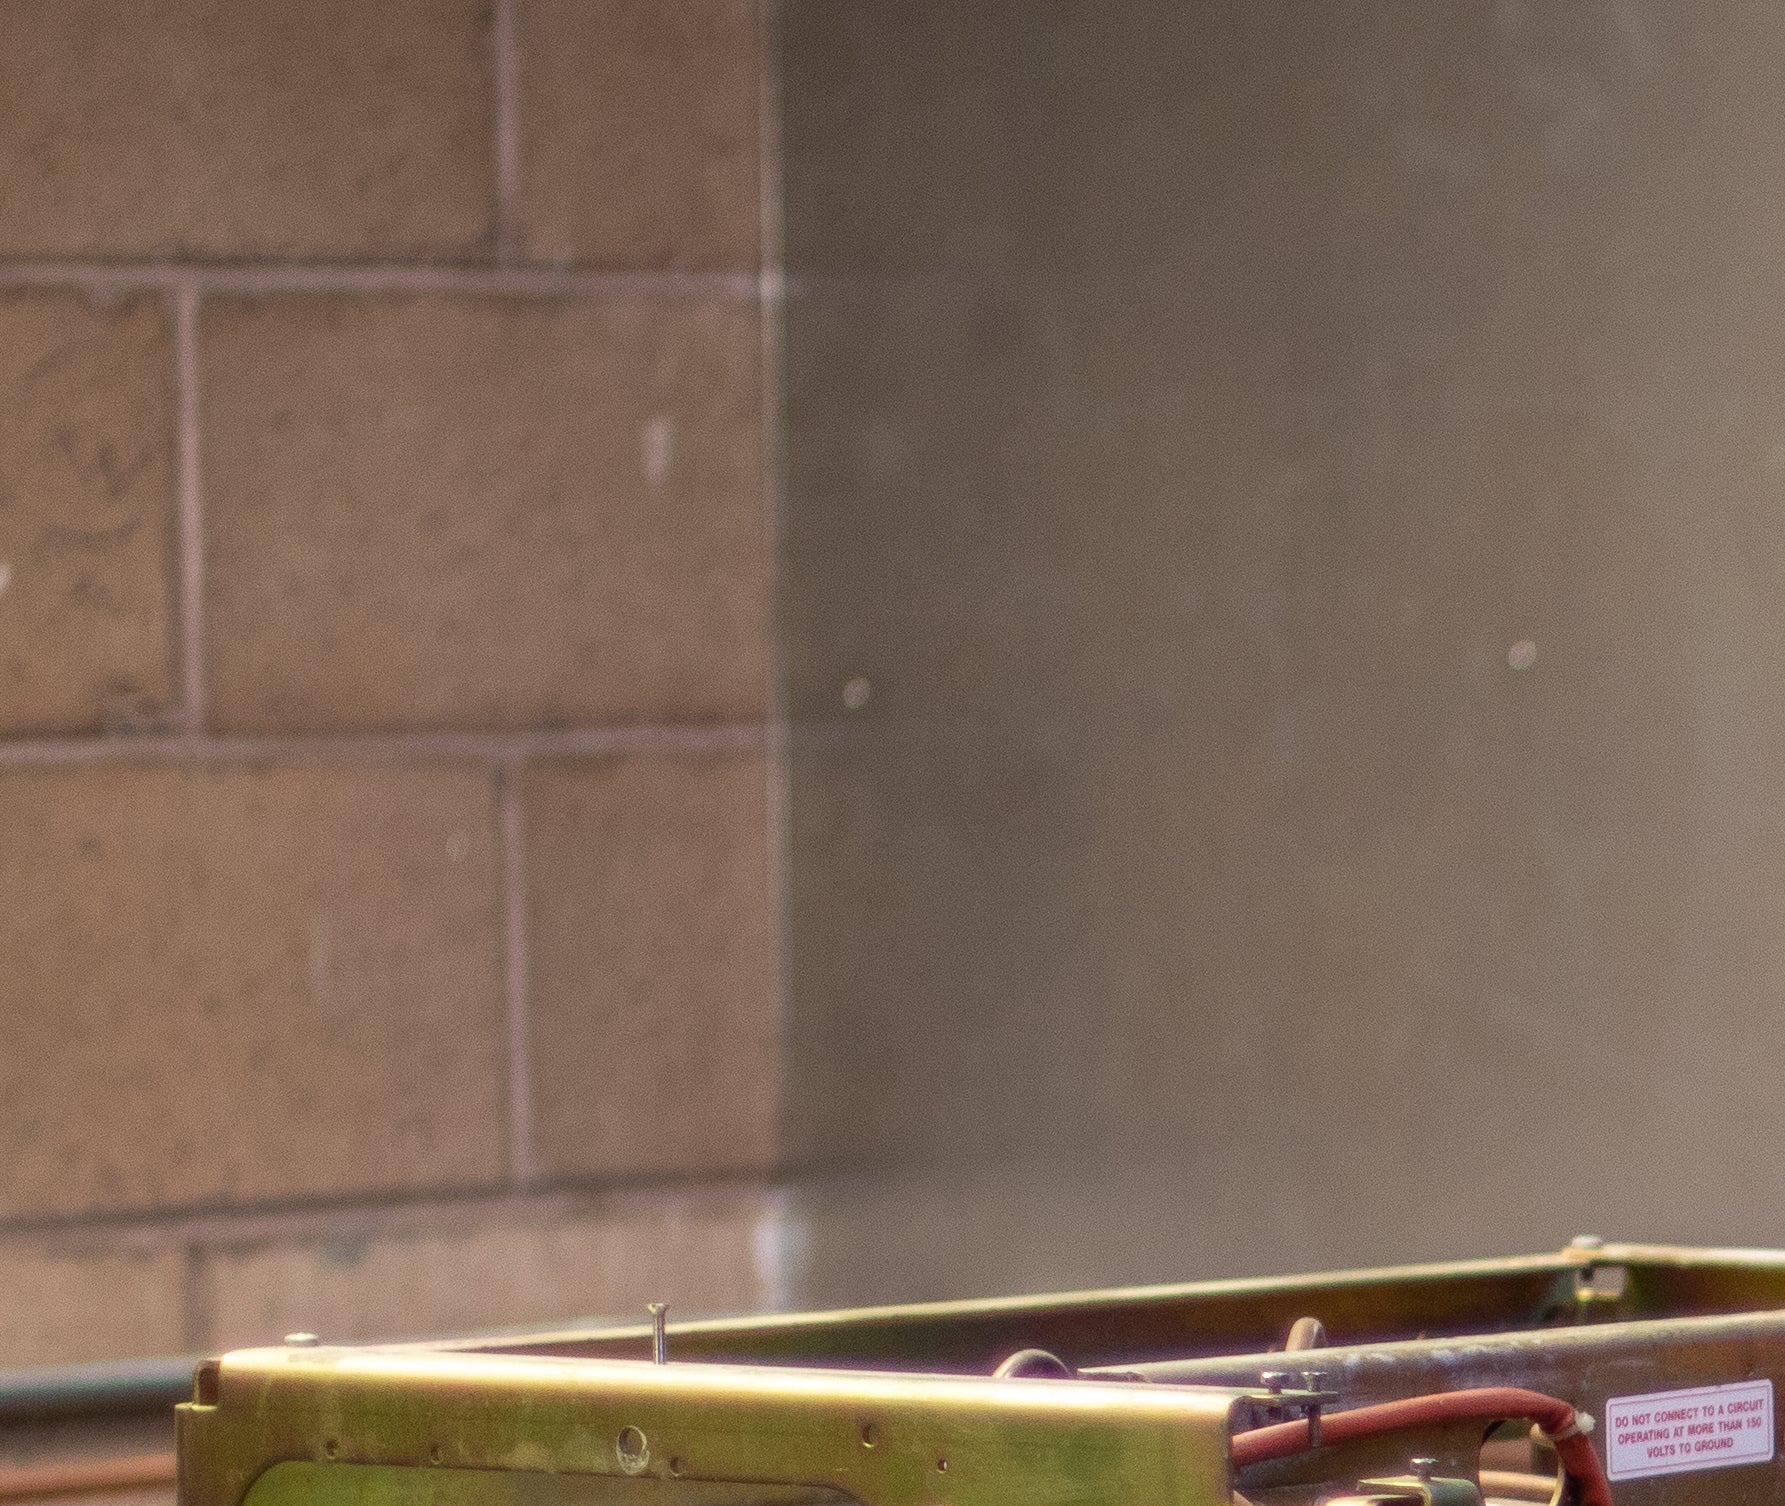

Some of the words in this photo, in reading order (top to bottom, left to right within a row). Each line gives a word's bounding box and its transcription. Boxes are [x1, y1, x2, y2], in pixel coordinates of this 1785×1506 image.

[1615, 1416, 1629, 1428] DO
[1632, 1413, 1651, 1426] NOT
[1654, 1407, 1699, 1424] CONNECT
[1702, 1404, 1715, 1417] TO
[1717, 1403, 1724, 1415] A
[1727, 1398, 1765, 1414] CIRCUIT
[1617, 1428, 1670, 1445] OPERATING
[1673, 1426, 1685, 1438] AT
[1687, 1422, 1714, 1436] MORE
[1718, 1418, 1743, 1432] THAN
[1746, 1416, 1762, 1428] 150
[1647, 1443, 1676, 1458] VOLTS
[1679, 1442, 1691, 1455] TO
[1694, 1437, 1734, 1452] GROUND
